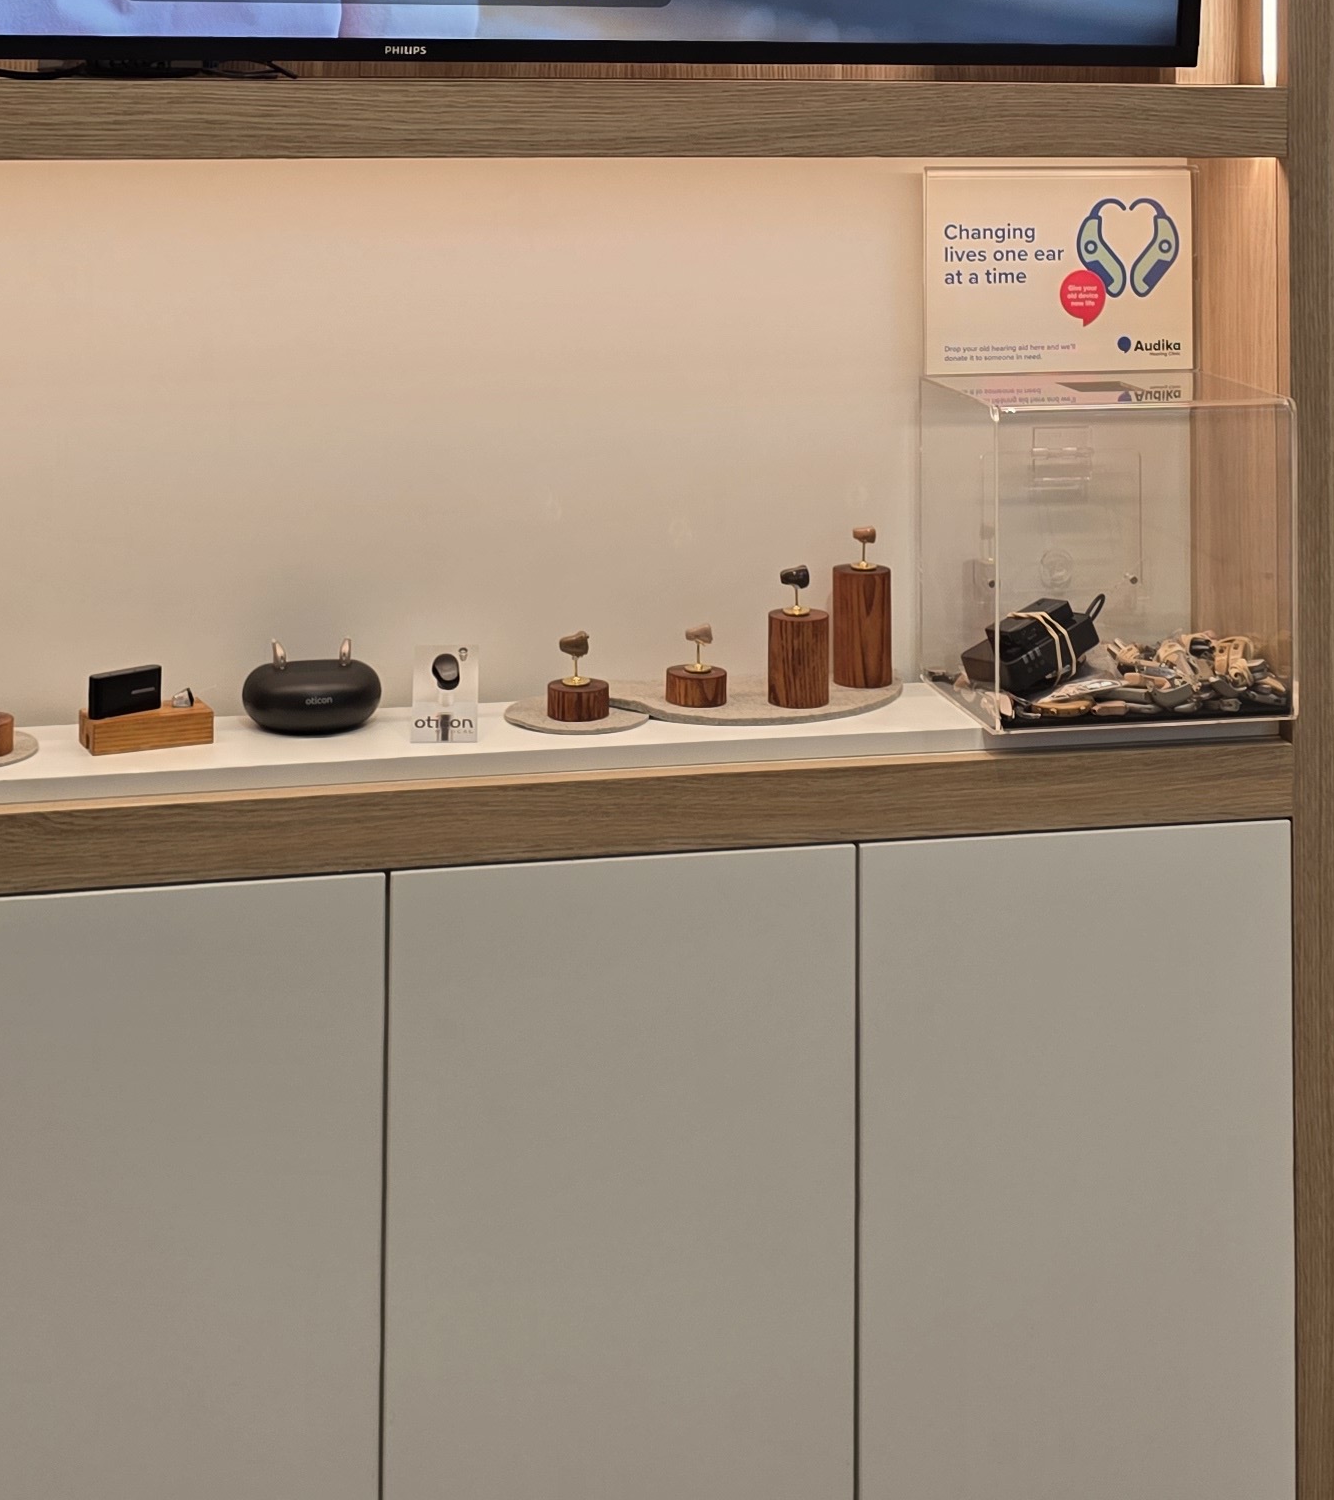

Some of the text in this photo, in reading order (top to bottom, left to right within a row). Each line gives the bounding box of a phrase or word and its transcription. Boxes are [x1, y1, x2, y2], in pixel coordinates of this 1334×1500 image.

[384, 45, 427, 55] PHILIPS
[944, 222, 1036, 243] Changing
[944, 246, 1065, 262] lives one ear
[944, 267, 1027, 284] at a time
[944, 345, 961, 353] Drop
[991, 345, 1016, 353] hearing
[1134, 339, 1181, 351] Audika
[944, 354, 968, 362] donate
[305, 696, 333, 706] oticon
[414, 715, 474, 729] otion
